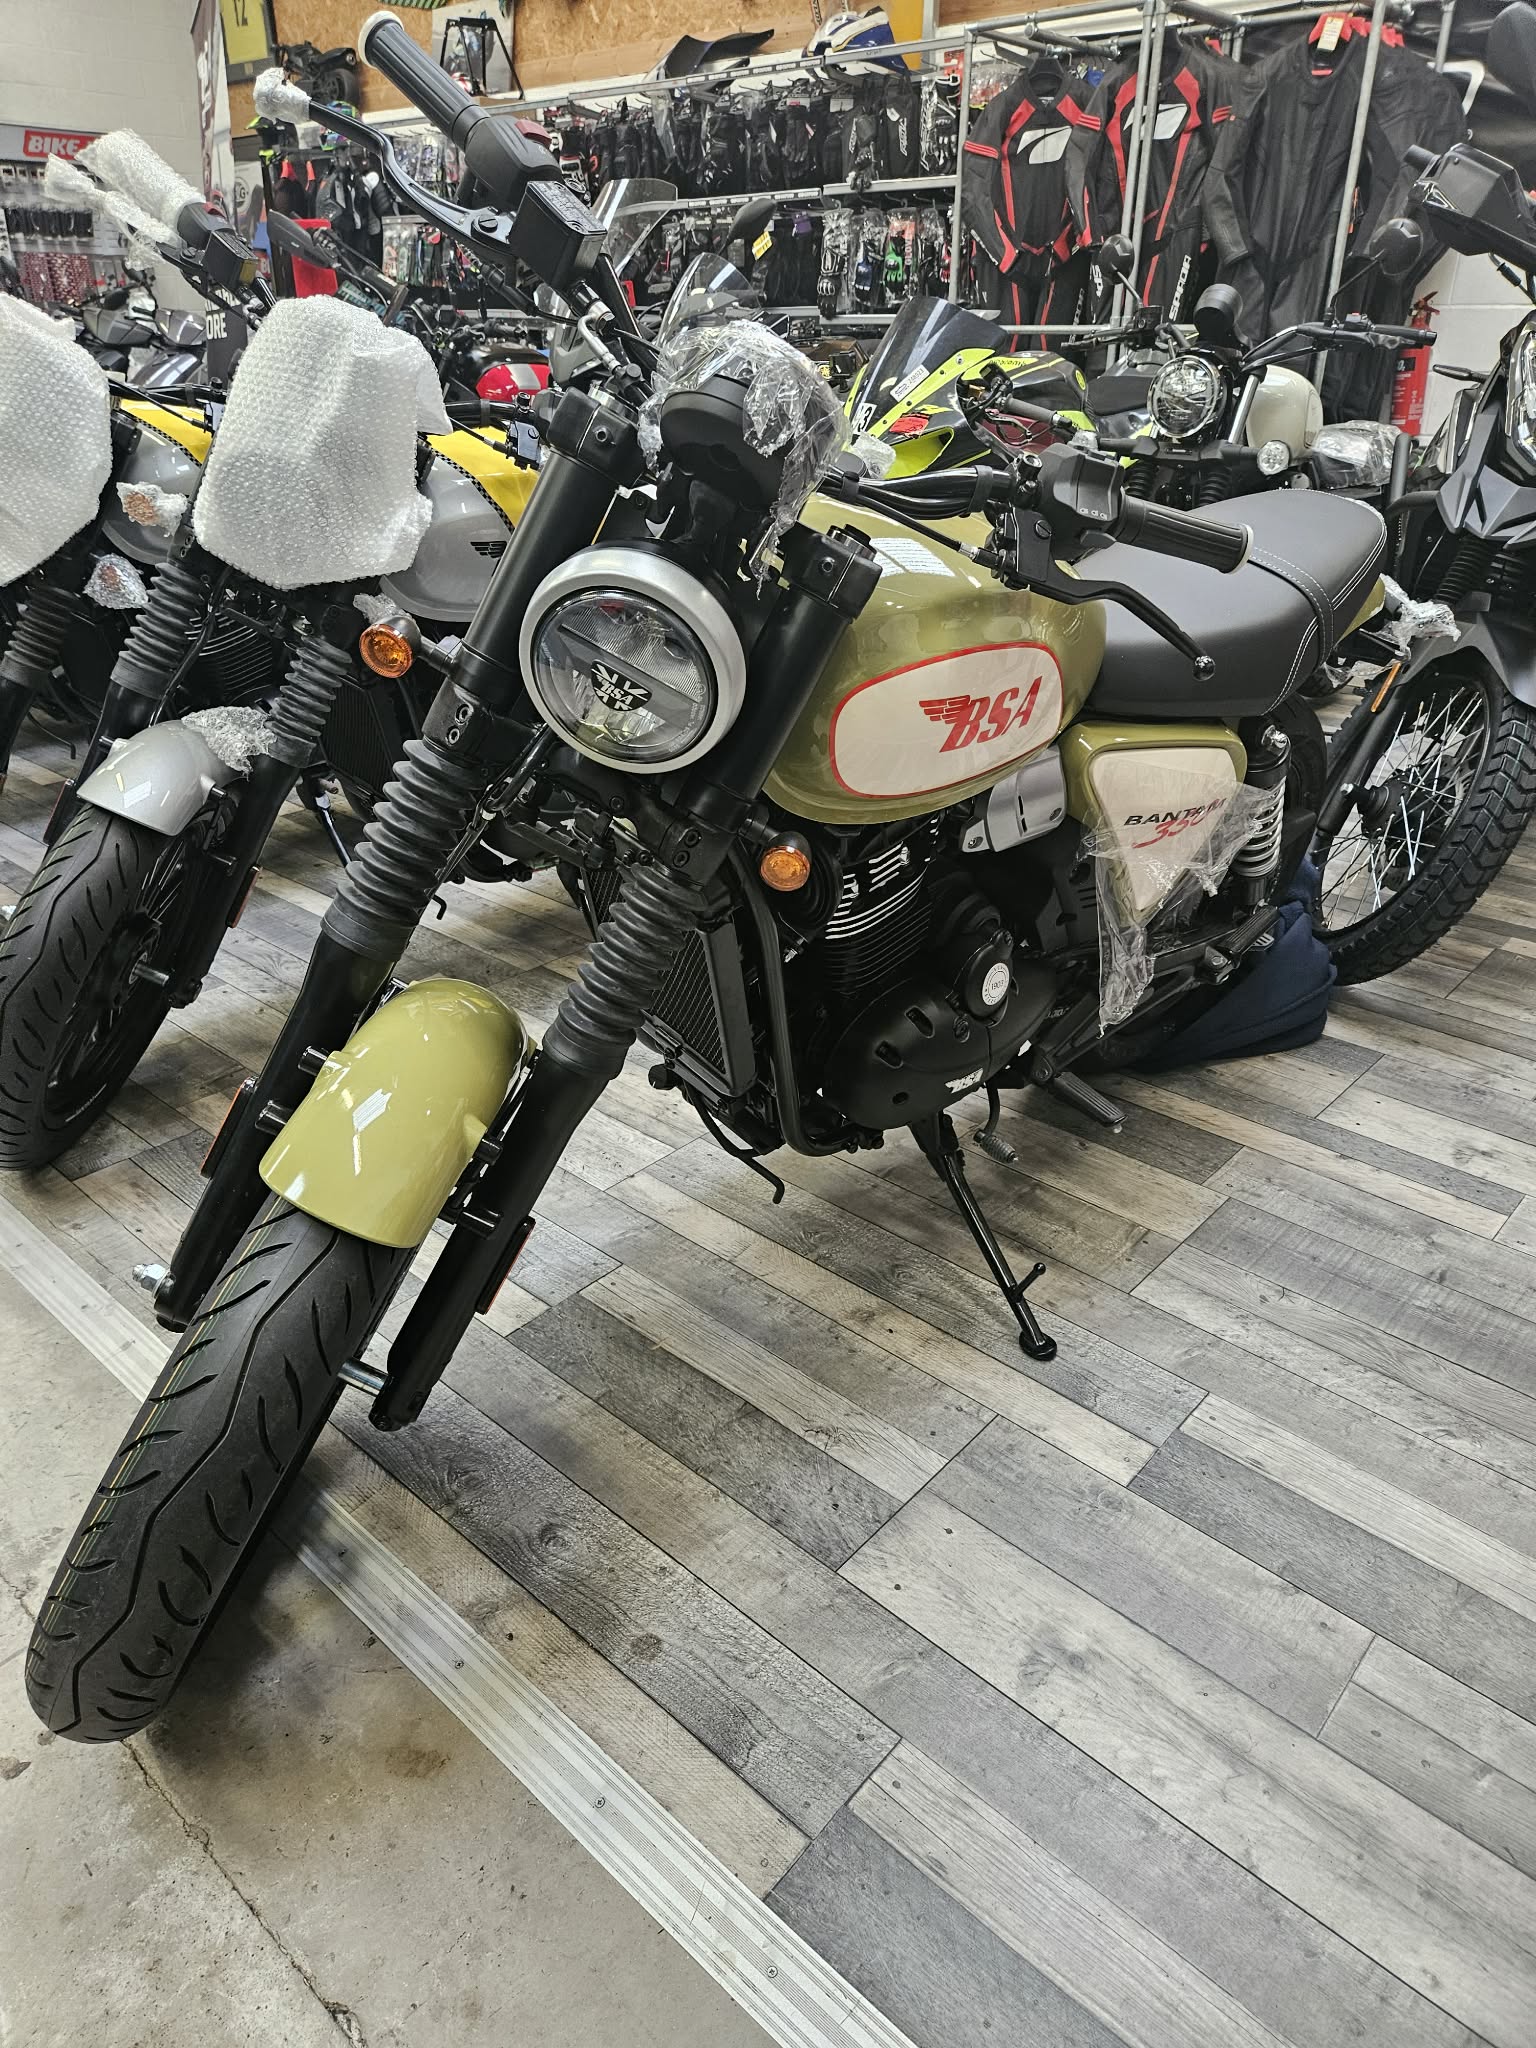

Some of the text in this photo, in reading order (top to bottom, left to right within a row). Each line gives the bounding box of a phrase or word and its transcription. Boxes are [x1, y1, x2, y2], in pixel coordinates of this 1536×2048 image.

[28, 135, 80, 156] BIKE
[1168, 254, 1192, 322] SPADA
[600, 680, 634, 705] BSA
[938, 676, 1043, 753] BSA
